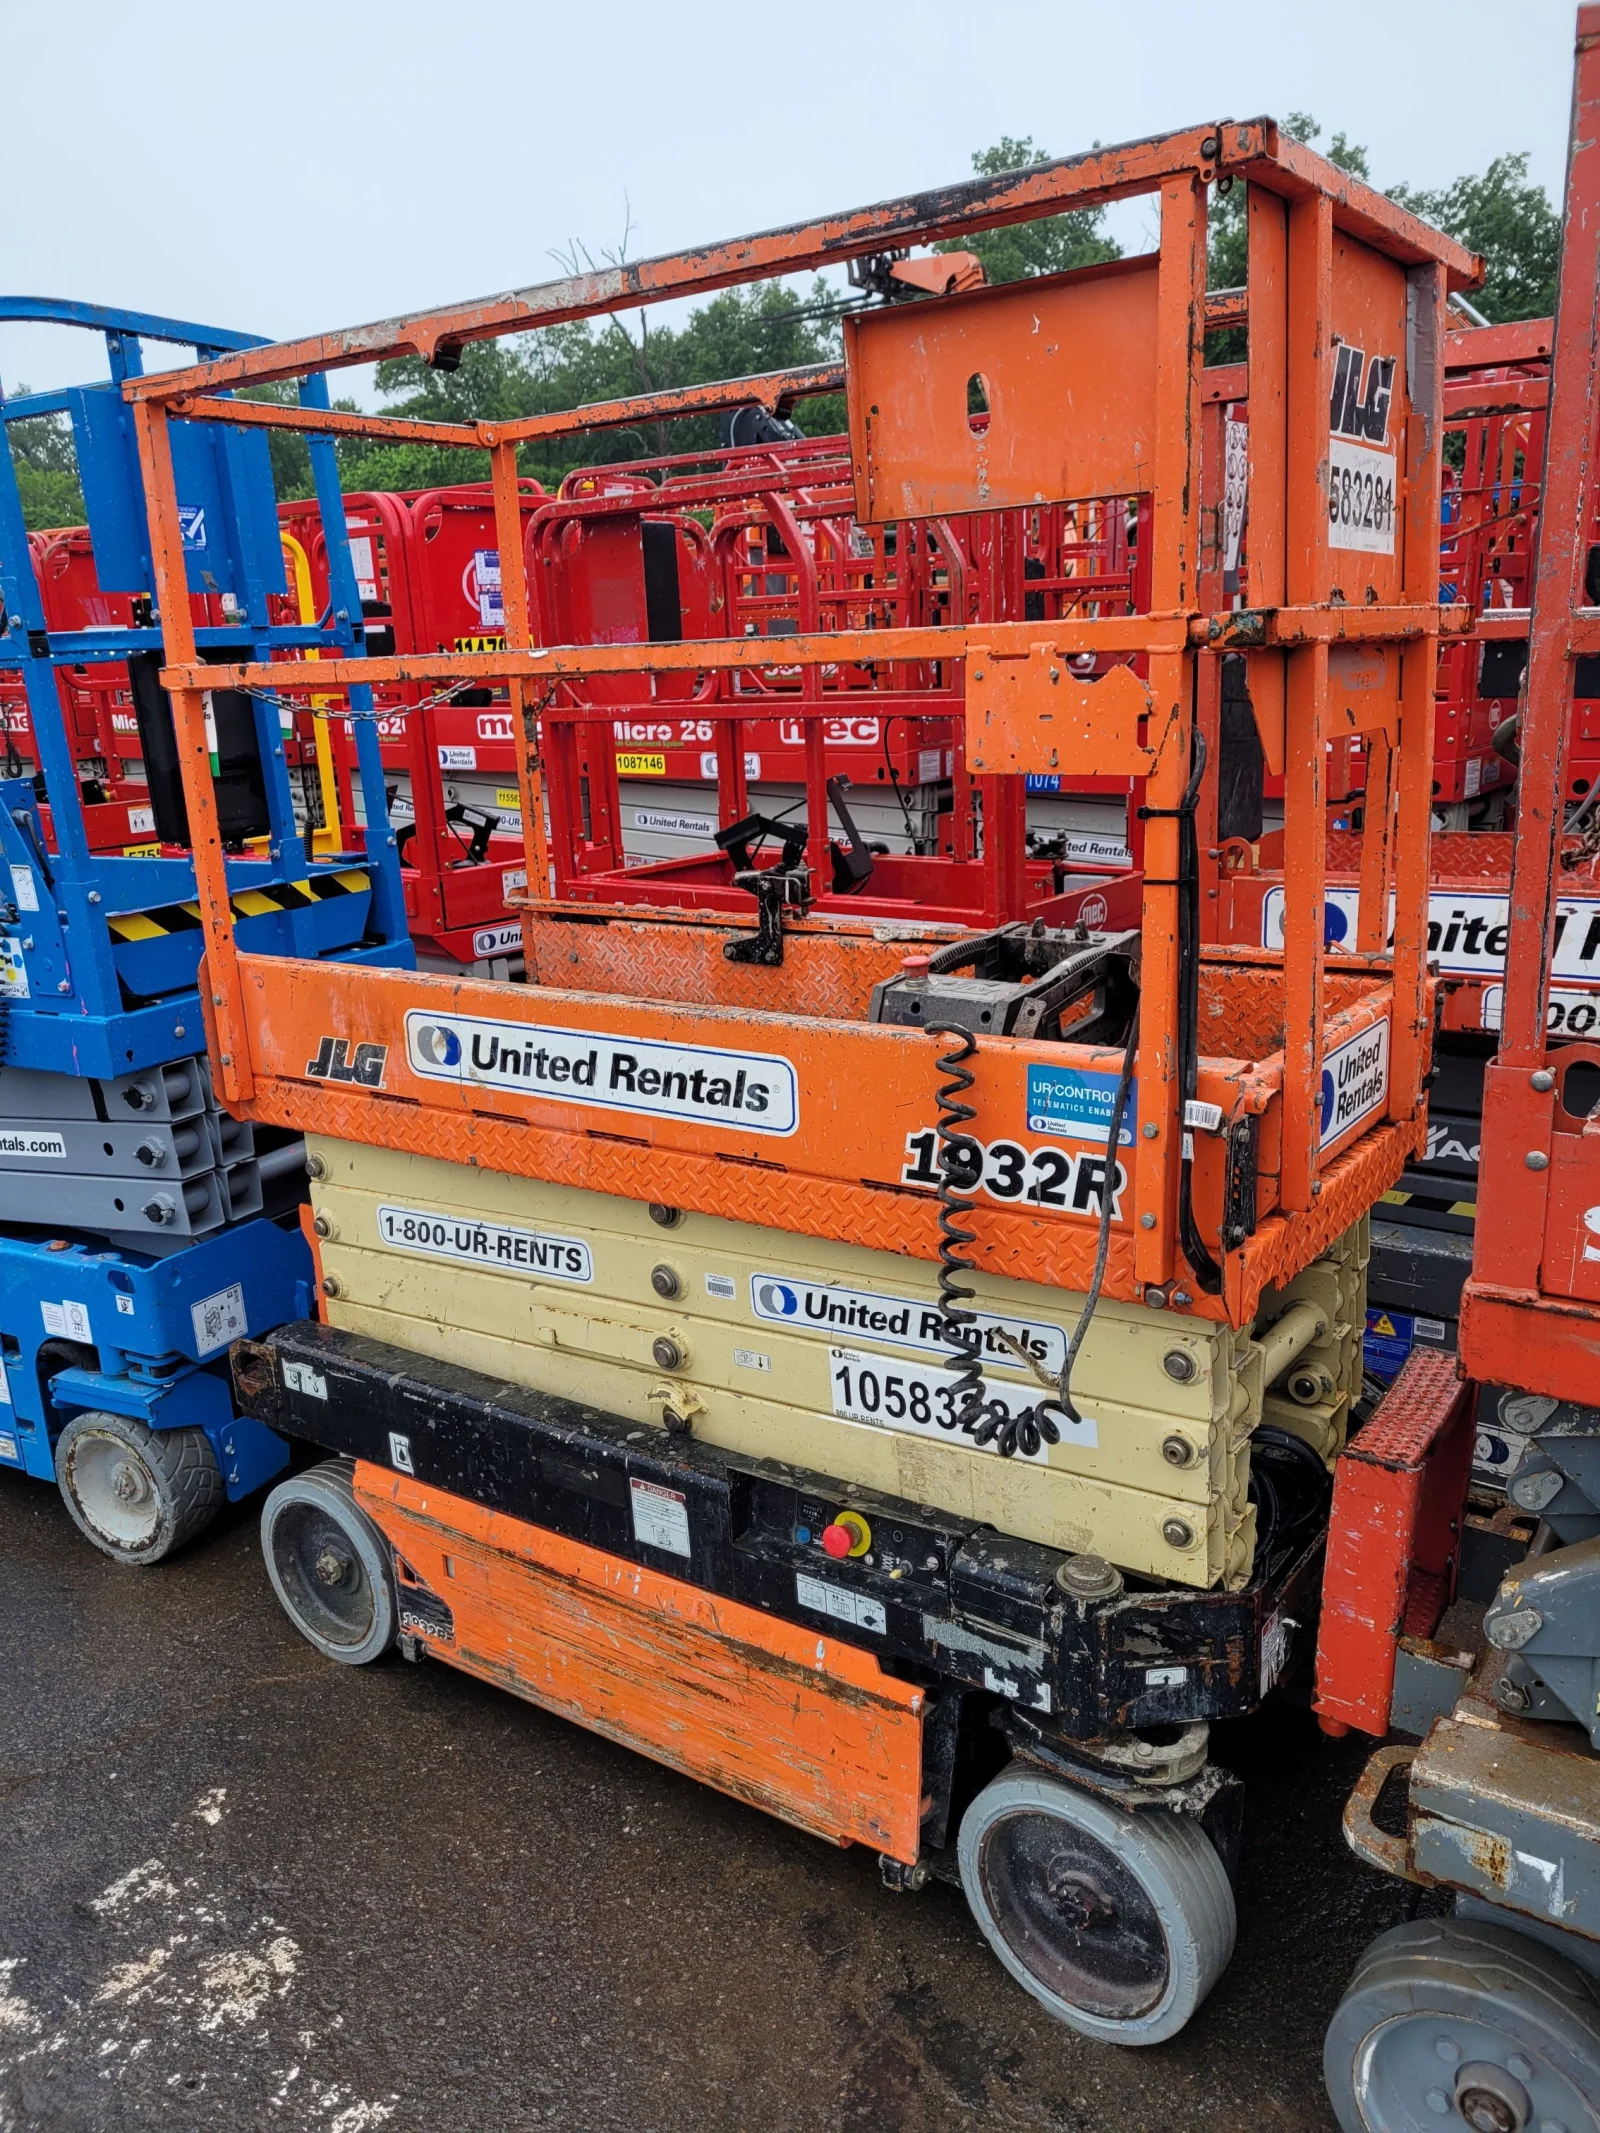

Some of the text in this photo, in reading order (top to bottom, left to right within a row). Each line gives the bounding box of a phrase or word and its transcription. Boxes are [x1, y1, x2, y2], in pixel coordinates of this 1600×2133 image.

[1330, 344, 1394, 443] JLG
[1329, 466, 1392, 532] 583281
[112, 714, 138, 730] Mic
[680, 720, 712, 741] 26
[450, 751, 470, 759] United
[450, 758, 473, 766] Rentals
[617, 756, 663, 769] 1087146
[649, 816, 710, 832] United Rentals
[1067, 842, 1133, 857] ted Rentals
[499, 932, 522, 944] Uni
[307, 1036, 388, 1087] JLG
[1338, 1032, 1382, 1085] United
[472, 1034, 770, 1113] United Rentals
[1335, 1067, 1384, 1124] Rentals
[1032, 1098, 1128, 1119] TELEMATICS ENABD
[905, 1132, 1122, 1215] 1932R
[385, 1215, 582, 1273] 1-800-UR-RENTS
[804, 1292, 910, 1336] United
[647, 1485, 676, 1500] DANGER
